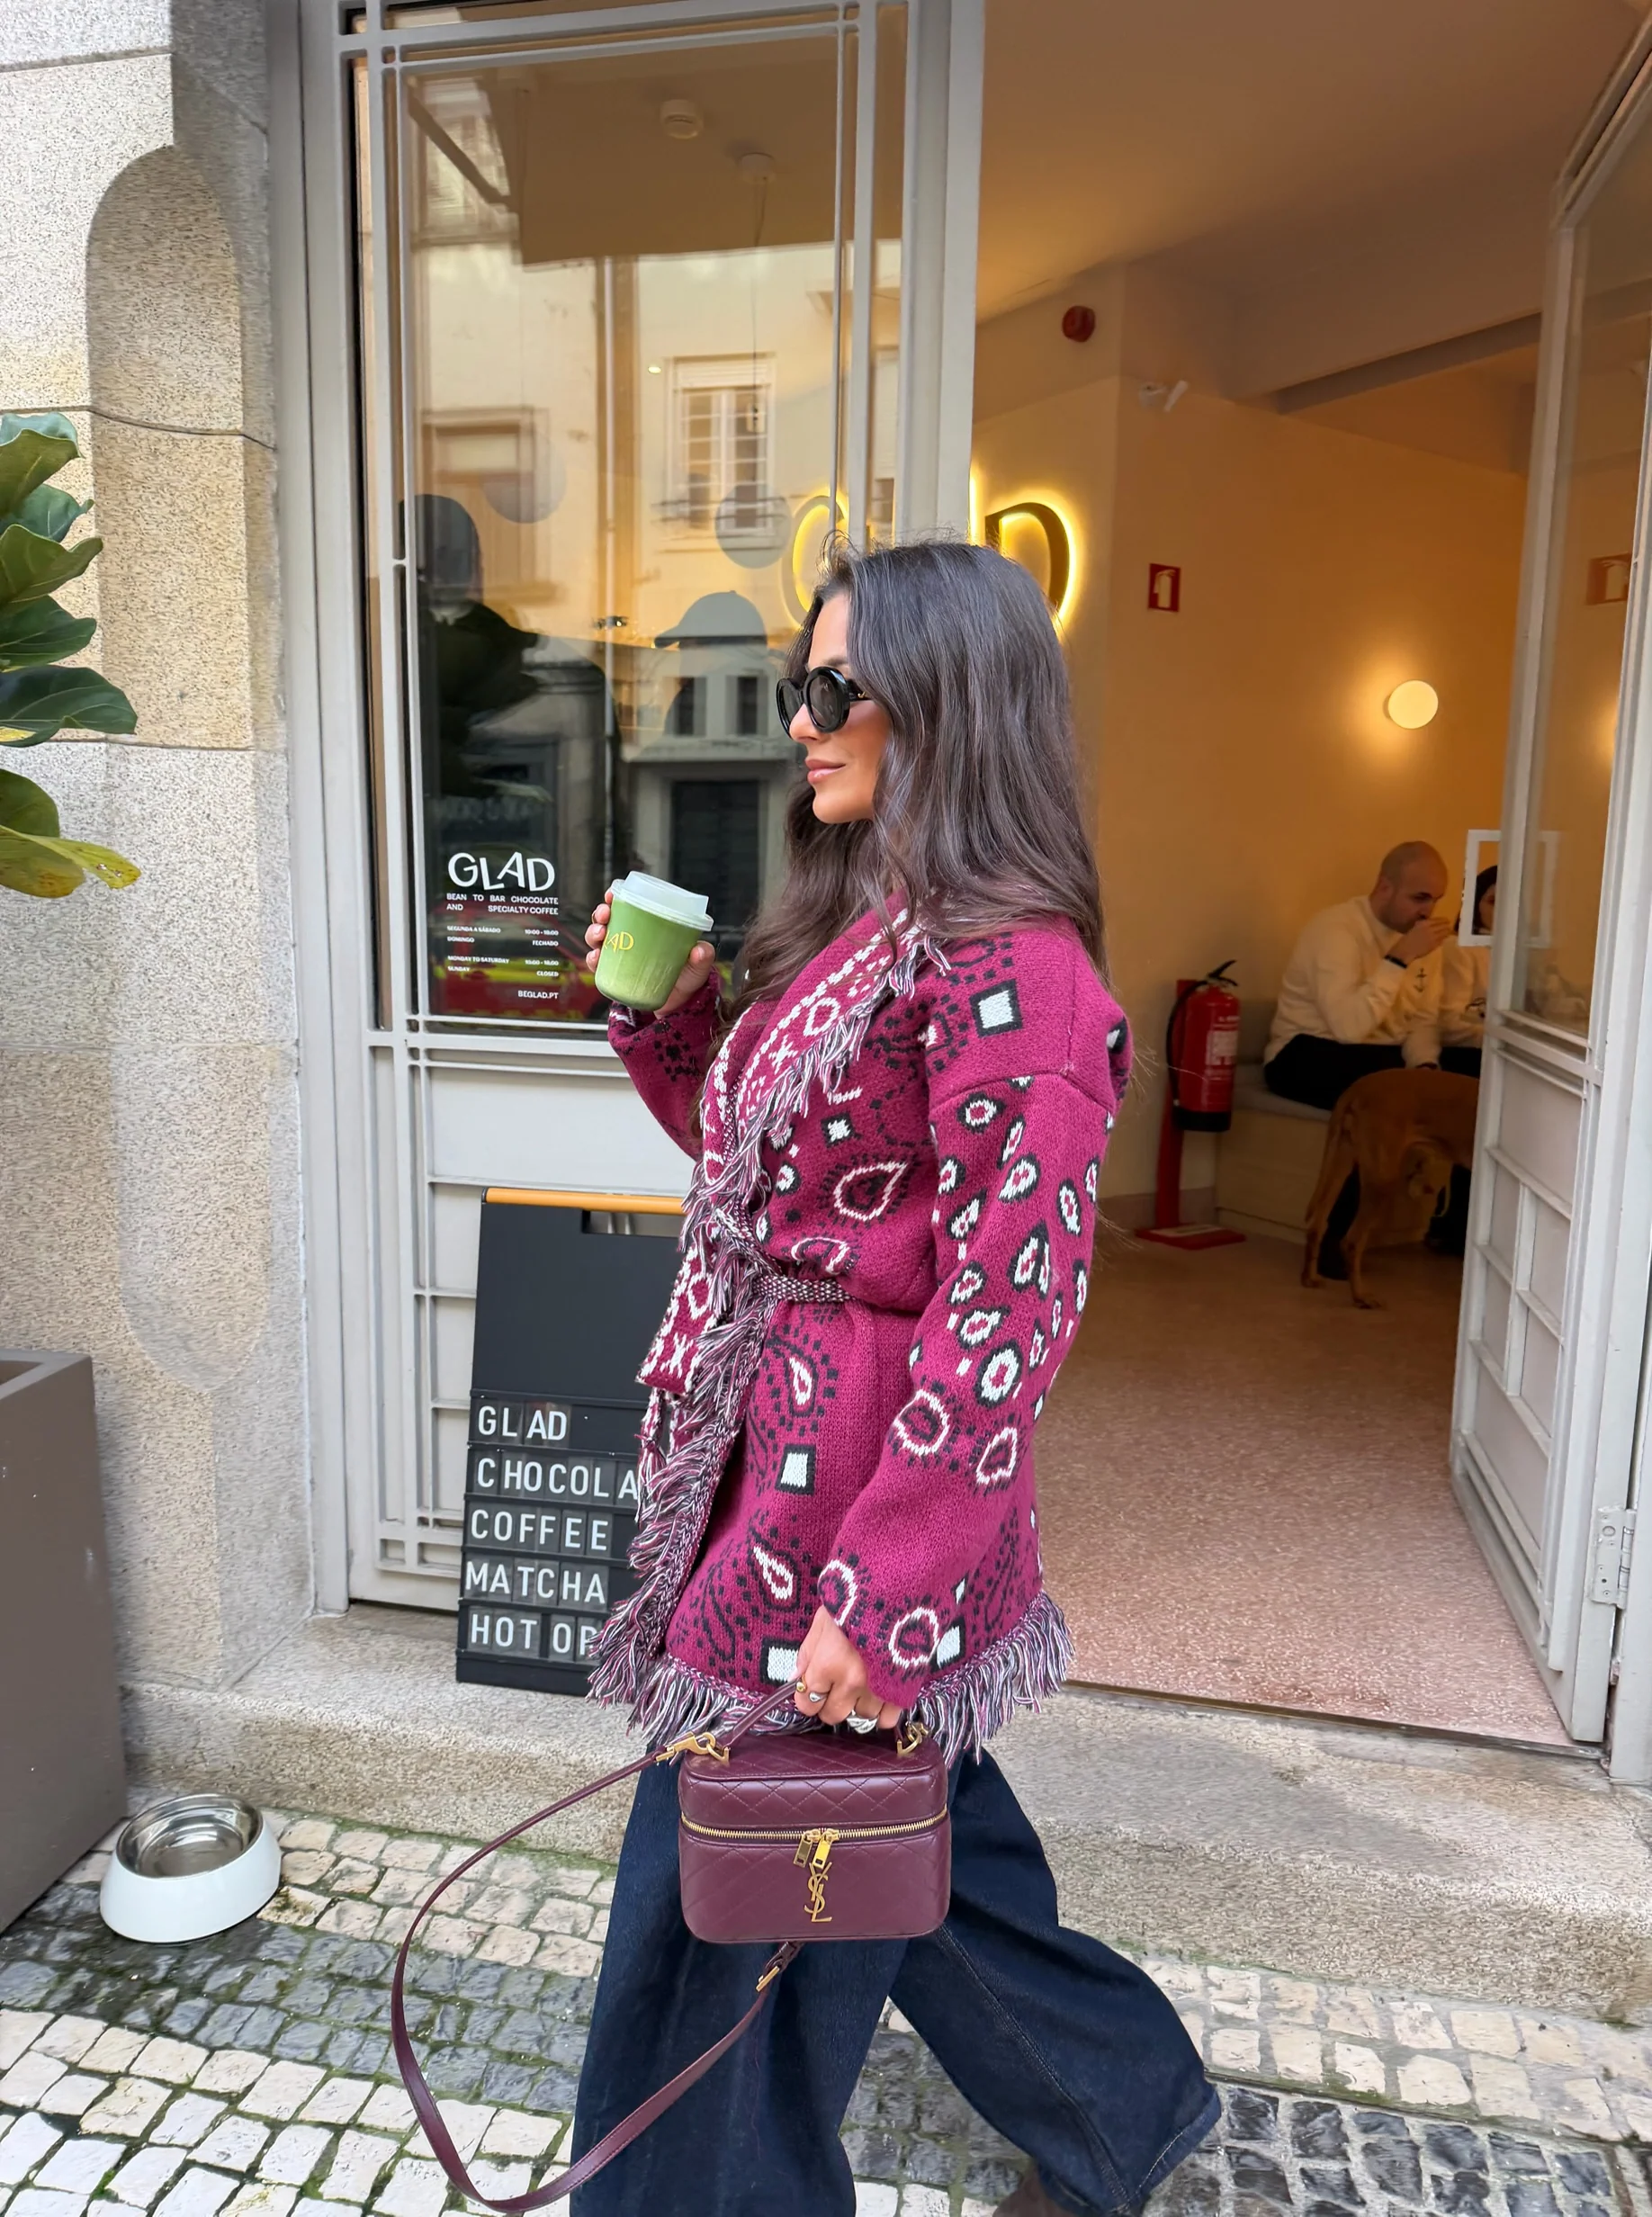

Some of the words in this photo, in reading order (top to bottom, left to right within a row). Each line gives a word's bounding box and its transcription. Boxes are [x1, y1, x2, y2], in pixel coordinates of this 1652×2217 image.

[448, 852, 555, 892] GLAD
[446, 893, 467, 901] BEAN
[511, 896, 559, 904] CHOCOLATE
[488, 905, 528, 913] SPECIALTY
[517, 991, 559, 999] BEGLAD.PT
[471, 1509, 608, 1550] COFFEE
[465, 1561, 605, 1603] MATCHA
[471, 1614, 537, 1649] HOT
